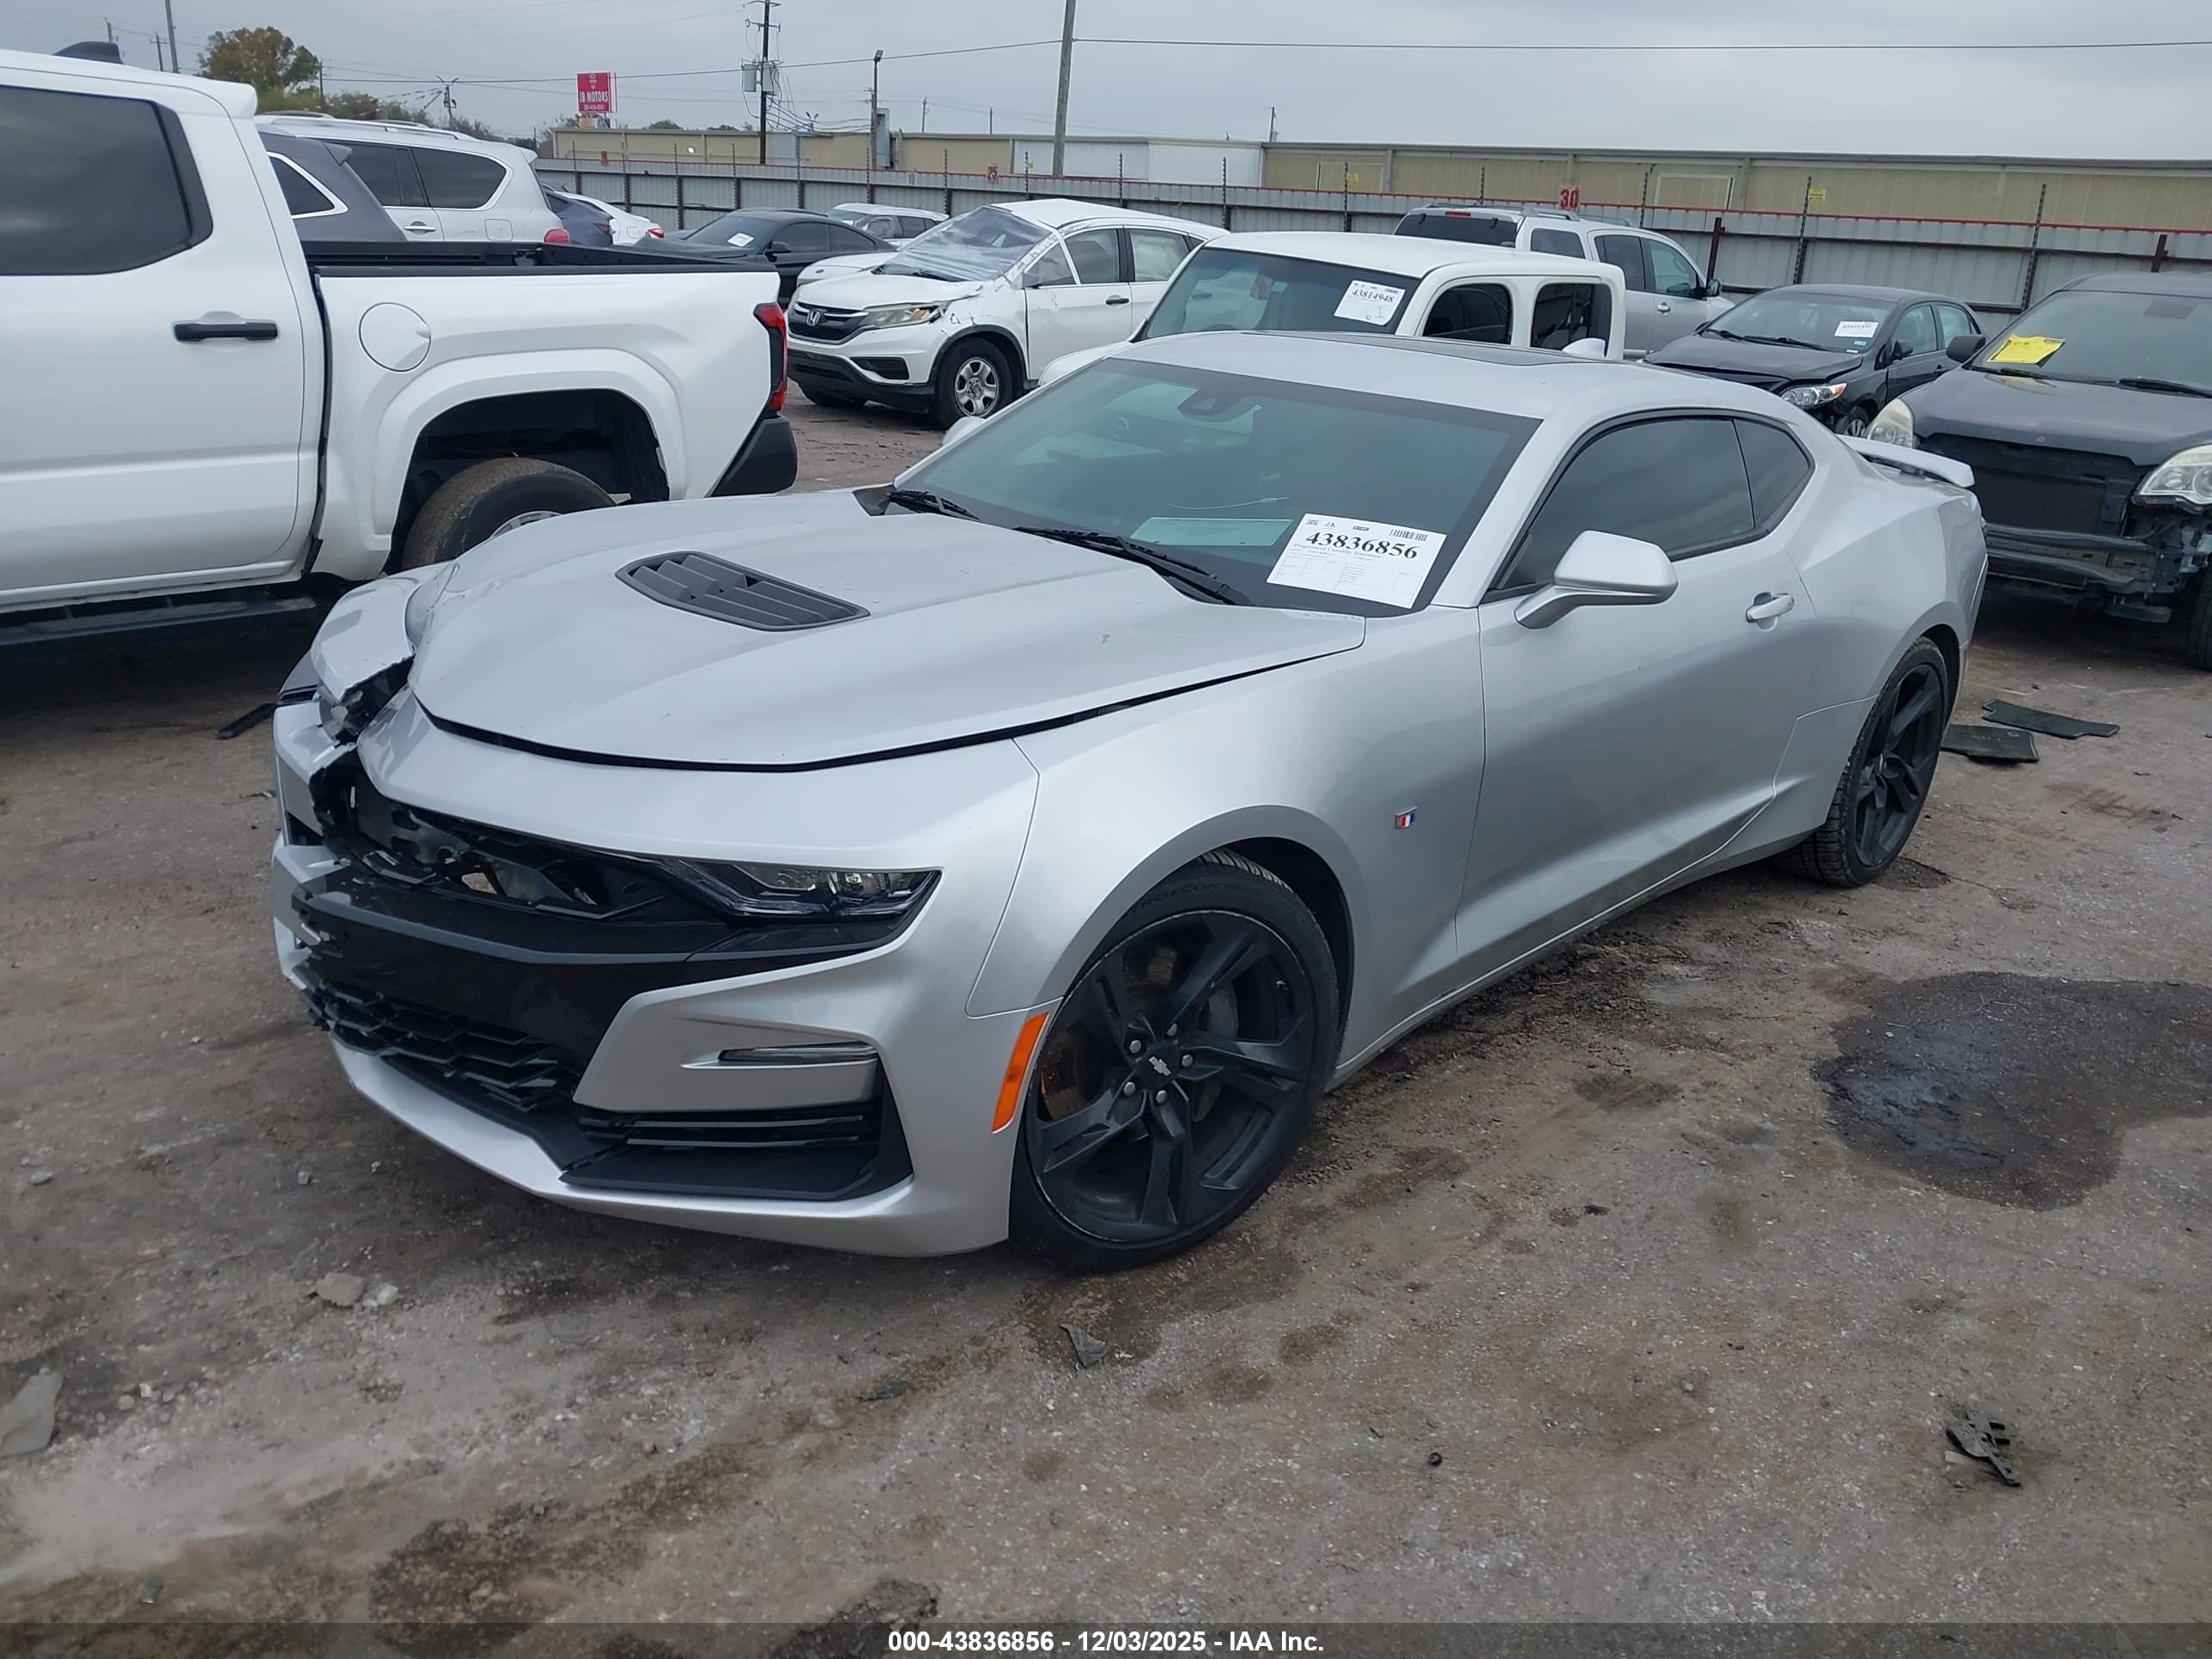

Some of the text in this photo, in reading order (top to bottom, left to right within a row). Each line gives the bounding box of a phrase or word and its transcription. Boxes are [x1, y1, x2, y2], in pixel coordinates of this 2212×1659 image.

[586, 90, 609, 103] MOTORS
[1559, 188, 1580, 210] 30
[1293, 543, 1327, 552] Progressive
[1305, 532, 1420, 560] 43836856
